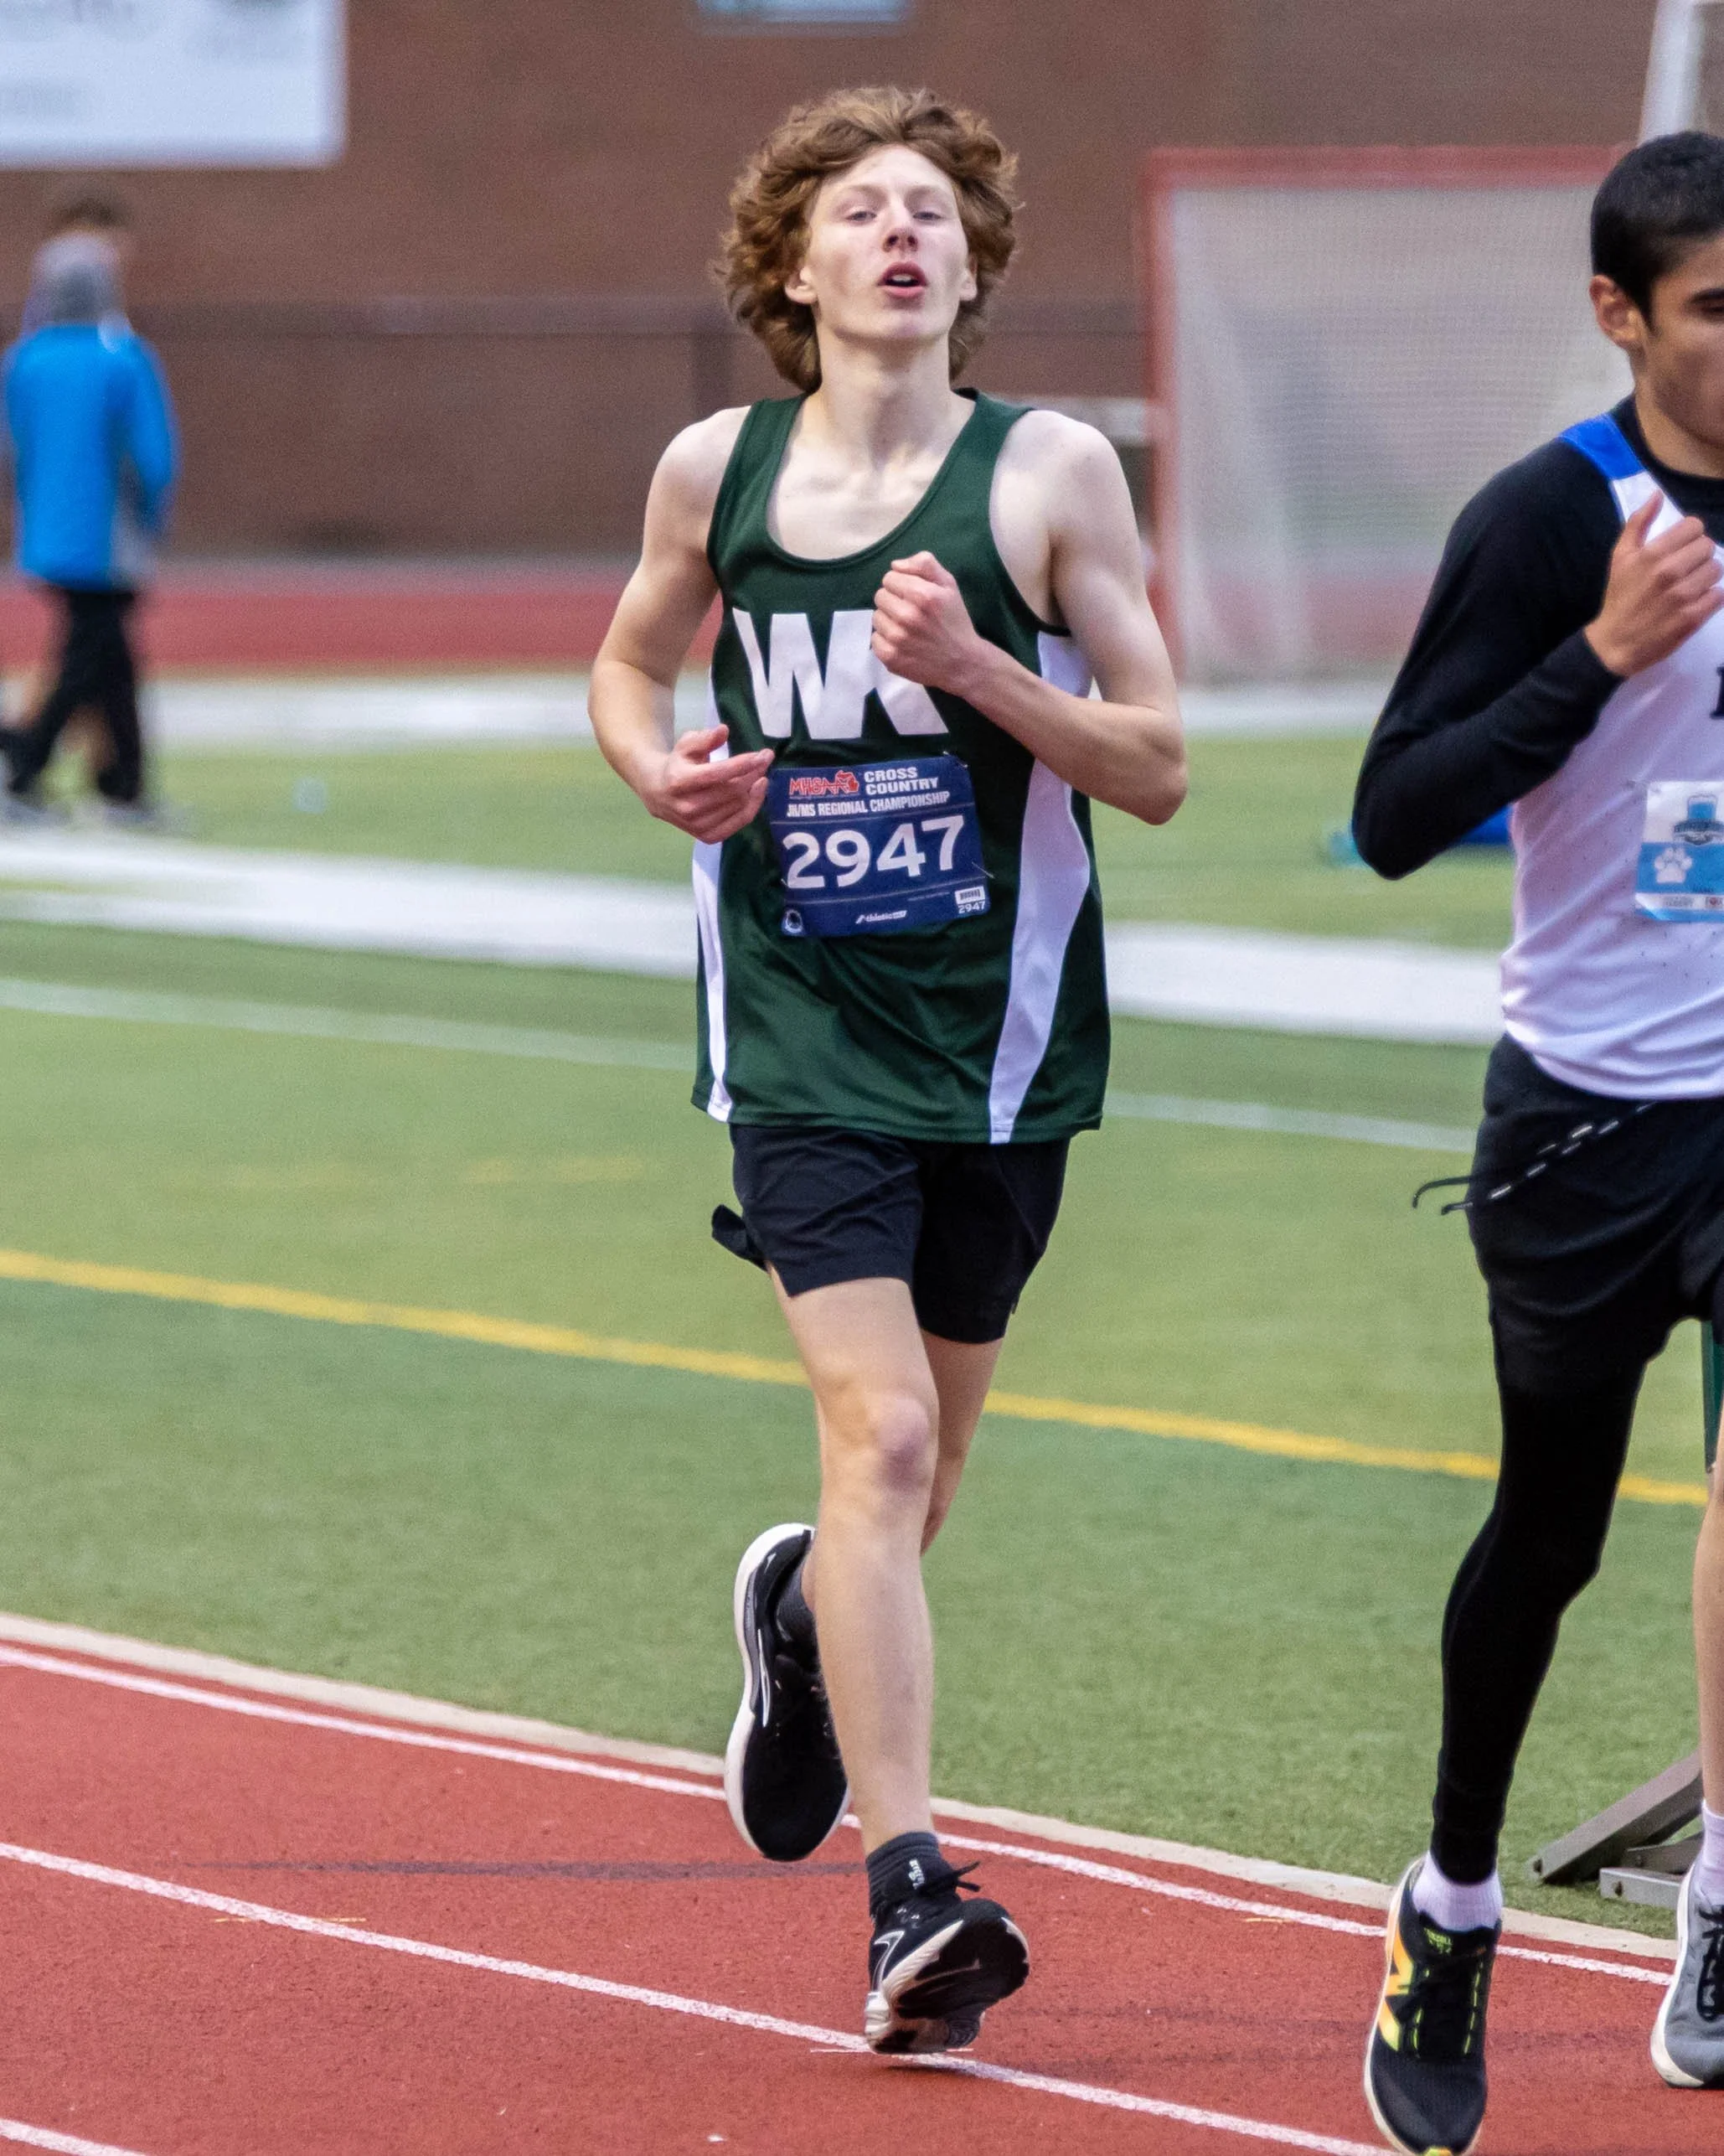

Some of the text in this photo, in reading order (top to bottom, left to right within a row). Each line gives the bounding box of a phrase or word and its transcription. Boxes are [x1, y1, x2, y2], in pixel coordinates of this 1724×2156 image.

[864, 767, 918, 783] CROSS
[865, 777, 938, 795] COUNTRY
[818, 800, 868, 816] REGIONAL
[870, 791, 950, 812] CHAMPIONSHIP
[782, 814, 964, 889] 2947
[957, 901, 985, 914] 2947
